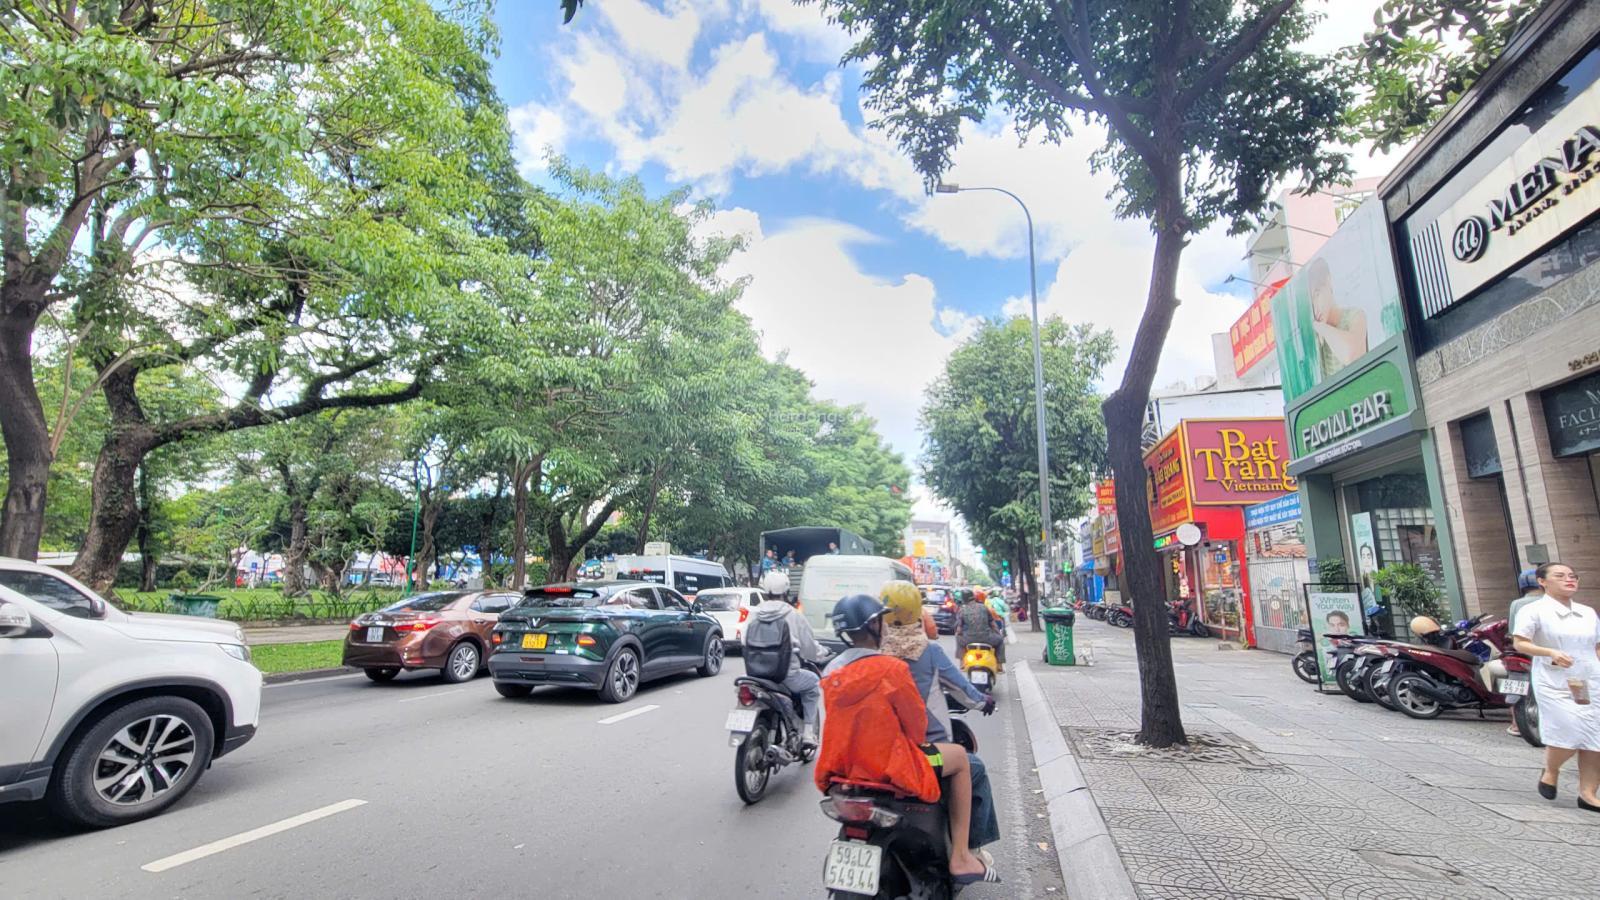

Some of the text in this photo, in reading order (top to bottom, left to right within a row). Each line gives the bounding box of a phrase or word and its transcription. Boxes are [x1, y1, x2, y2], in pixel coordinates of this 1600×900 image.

[1302, 391, 1389, 450] FACIAL BAR
[1559, 407, 1600, 428] FACI
[1220, 479, 1284, 492] Vietnam
